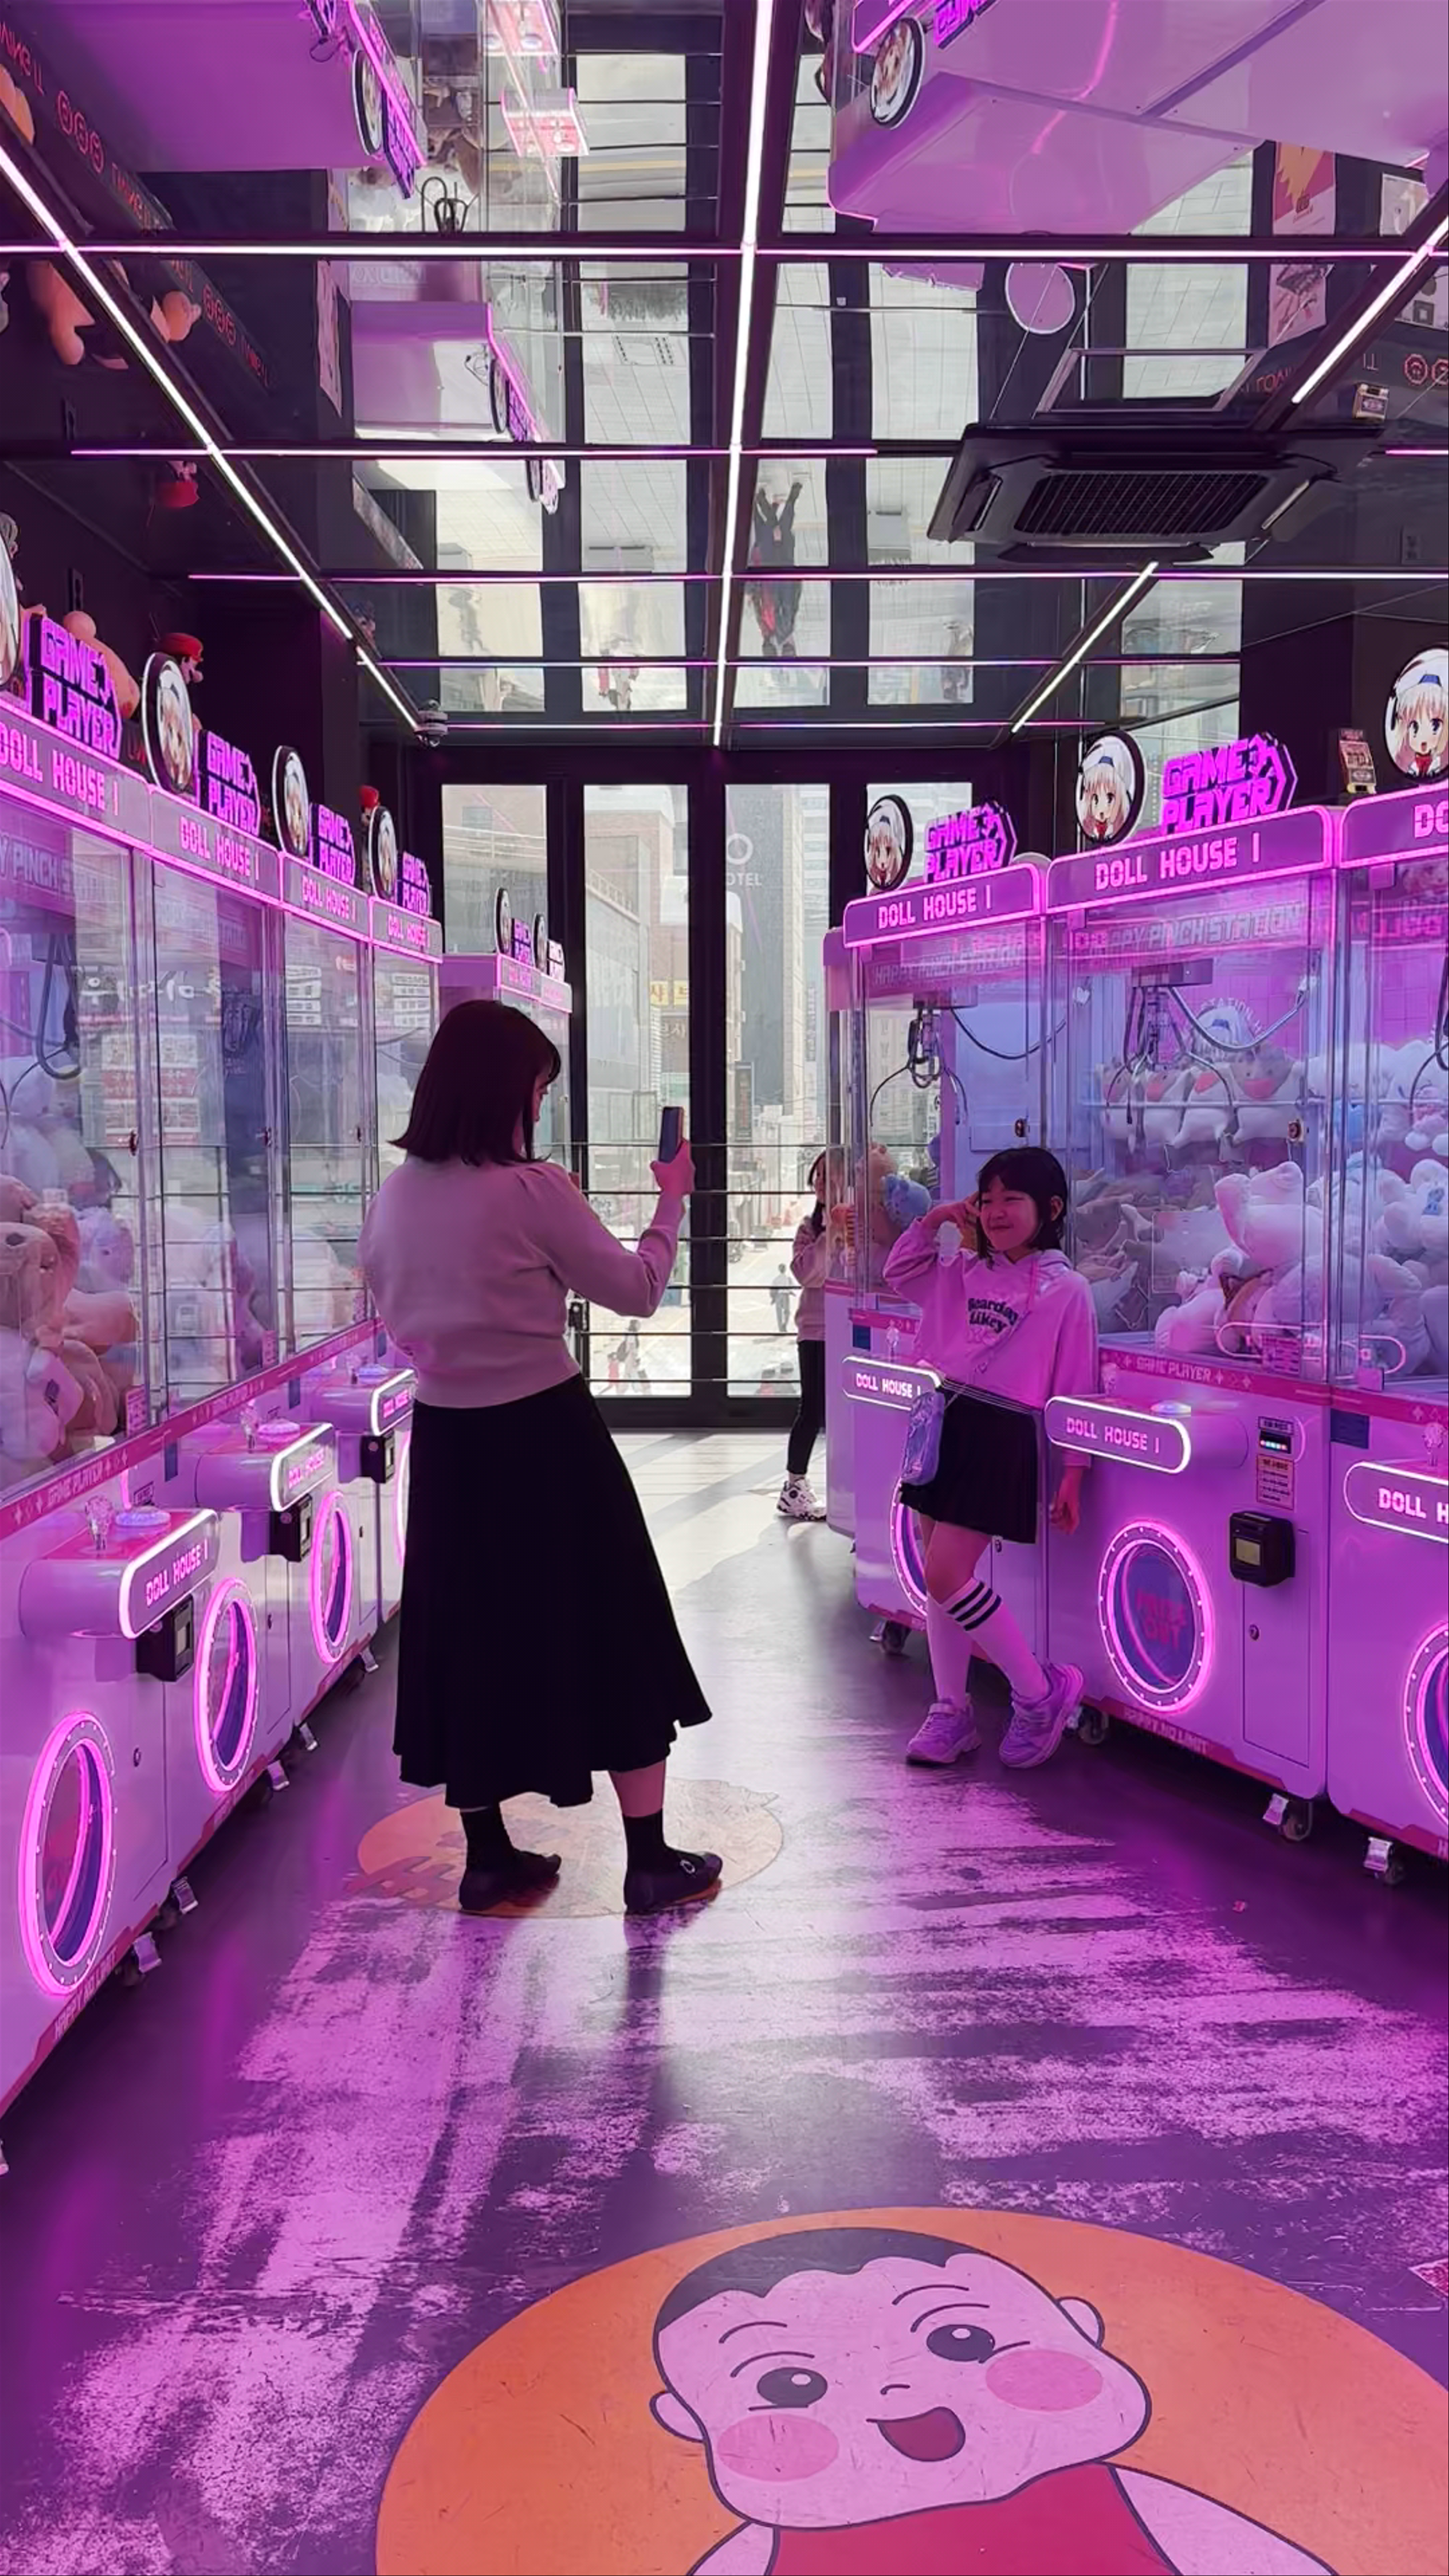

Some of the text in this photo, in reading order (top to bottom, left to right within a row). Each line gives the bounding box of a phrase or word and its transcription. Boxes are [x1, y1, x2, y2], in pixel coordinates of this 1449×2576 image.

[43, 672, 116, 755] PLAYER
[0, 722, 43, 782] DOLL
[52, 749, 106, 811] HOUSE
[1164, 739, 1249, 797] GAME
[1162, 778, 1271, 835] PLAYER
[180, 815, 211, 859] DOLL
[216, 833, 251, 876] HOUSE
[925, 838, 1003, 882] PLAYER
[1095, 856, 1148, 890] DOLL
[1160, 837, 1237, 879] HOUSE
[726, 873, 762, 886] OTEL
[878, 903, 916, 929] DOLL
[923, 888, 977, 920] HOUSE
[856, 1373, 878, 1391] DOLL
[881, 1377, 913, 1398] HOUSE
[1169, 1362, 1211, 1382] PLAYER
[1066, 1417, 1098, 1439] DOLL
[1104, 1426, 1148, 1451] HOUSE
[1378, 1487, 1426, 1519] DOLL
[146, 1569, 169, 1606] DOLL
[173, 1544, 201, 1585] HOUSE
